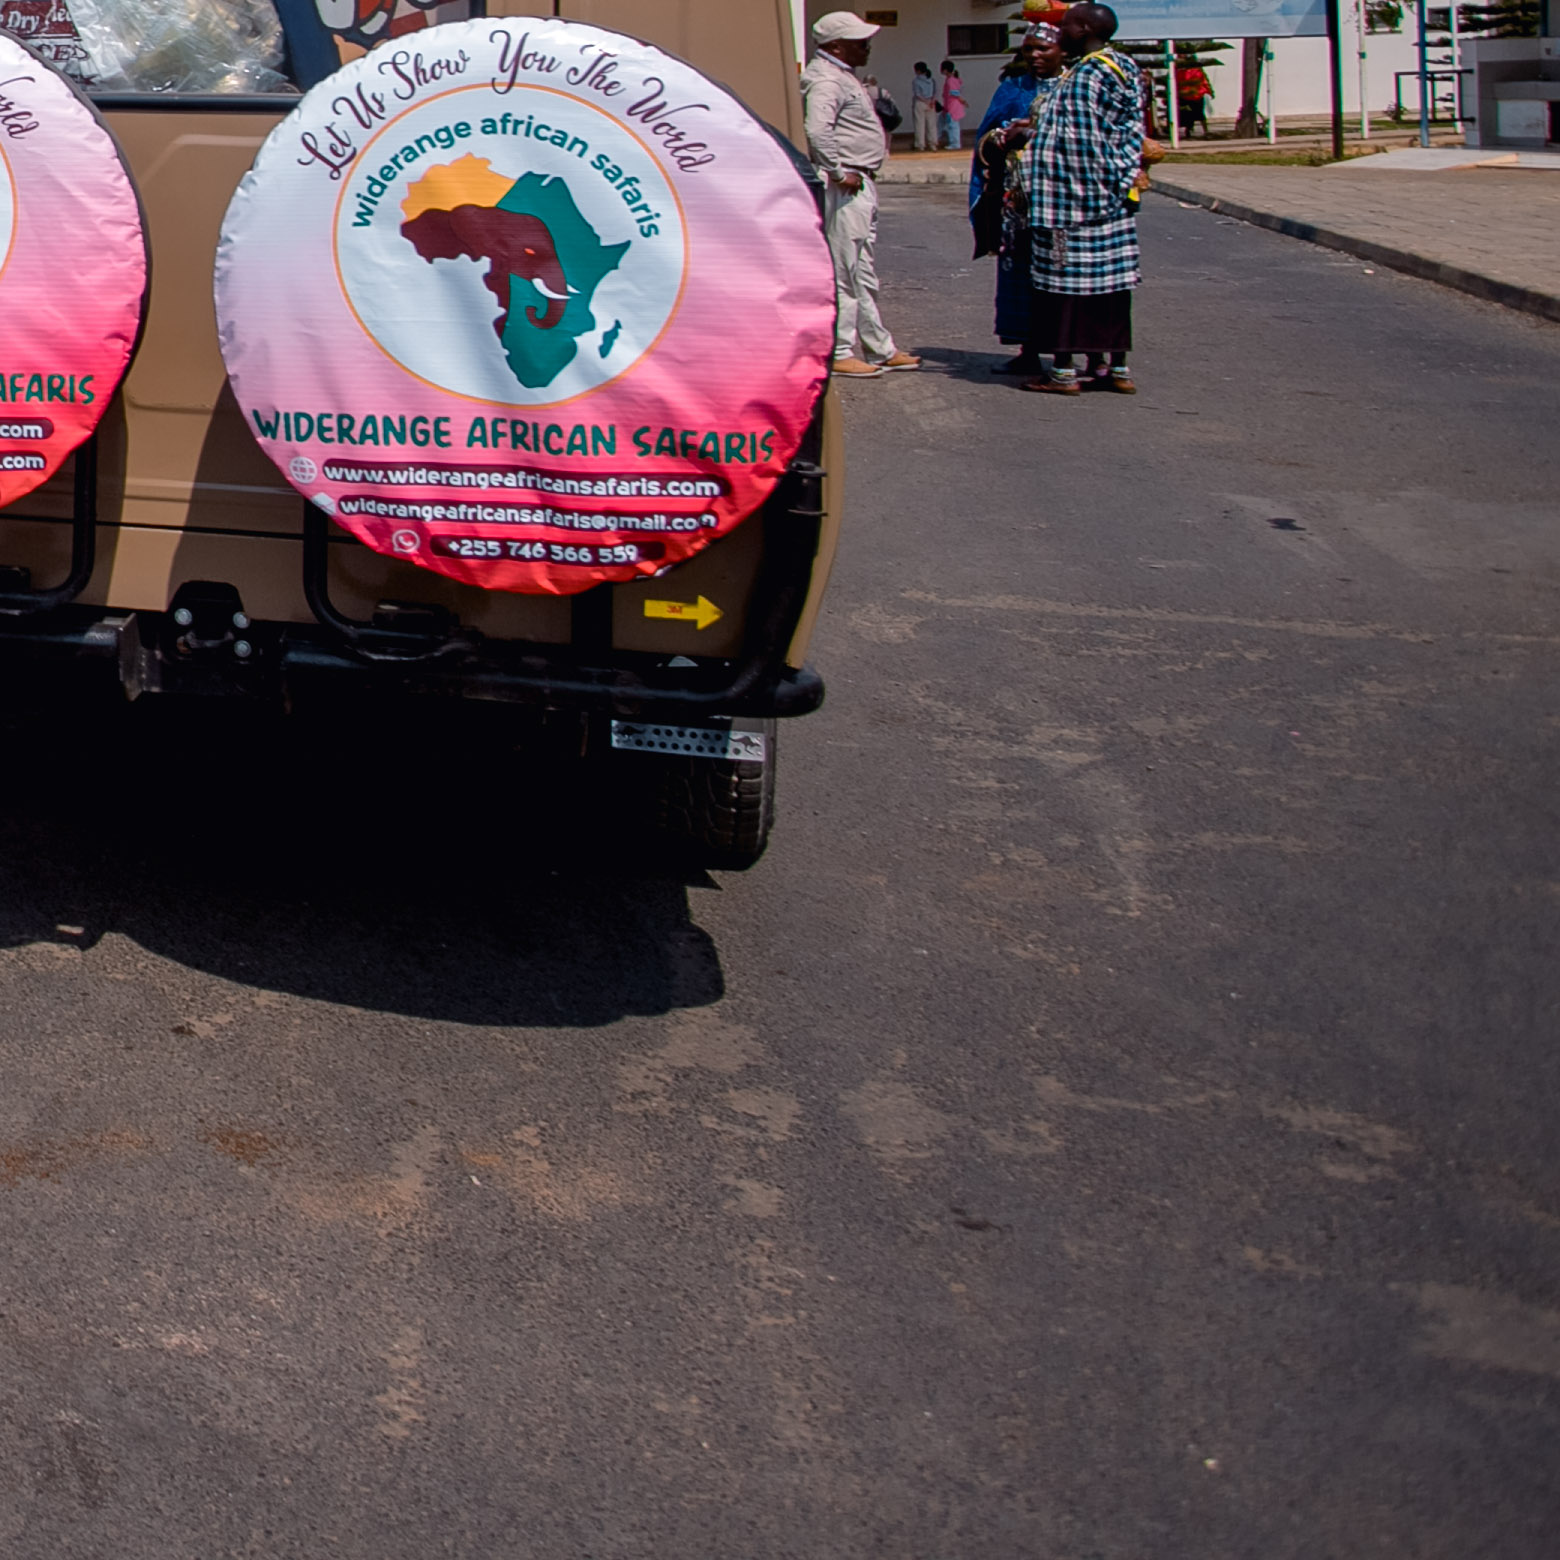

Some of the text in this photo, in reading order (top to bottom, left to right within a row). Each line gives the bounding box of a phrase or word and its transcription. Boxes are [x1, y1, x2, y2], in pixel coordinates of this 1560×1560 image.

[298, 30, 715, 181] Let Us Show You The World
[351, 112, 659, 239] widerange african safaris
[252, 409, 774, 464] WIDERANGE AFRICAN SAFARIS
[325, 463, 720, 497] www.widerangeafricansafaris.com
[449, 539, 637, 564] +255 746 566 559
